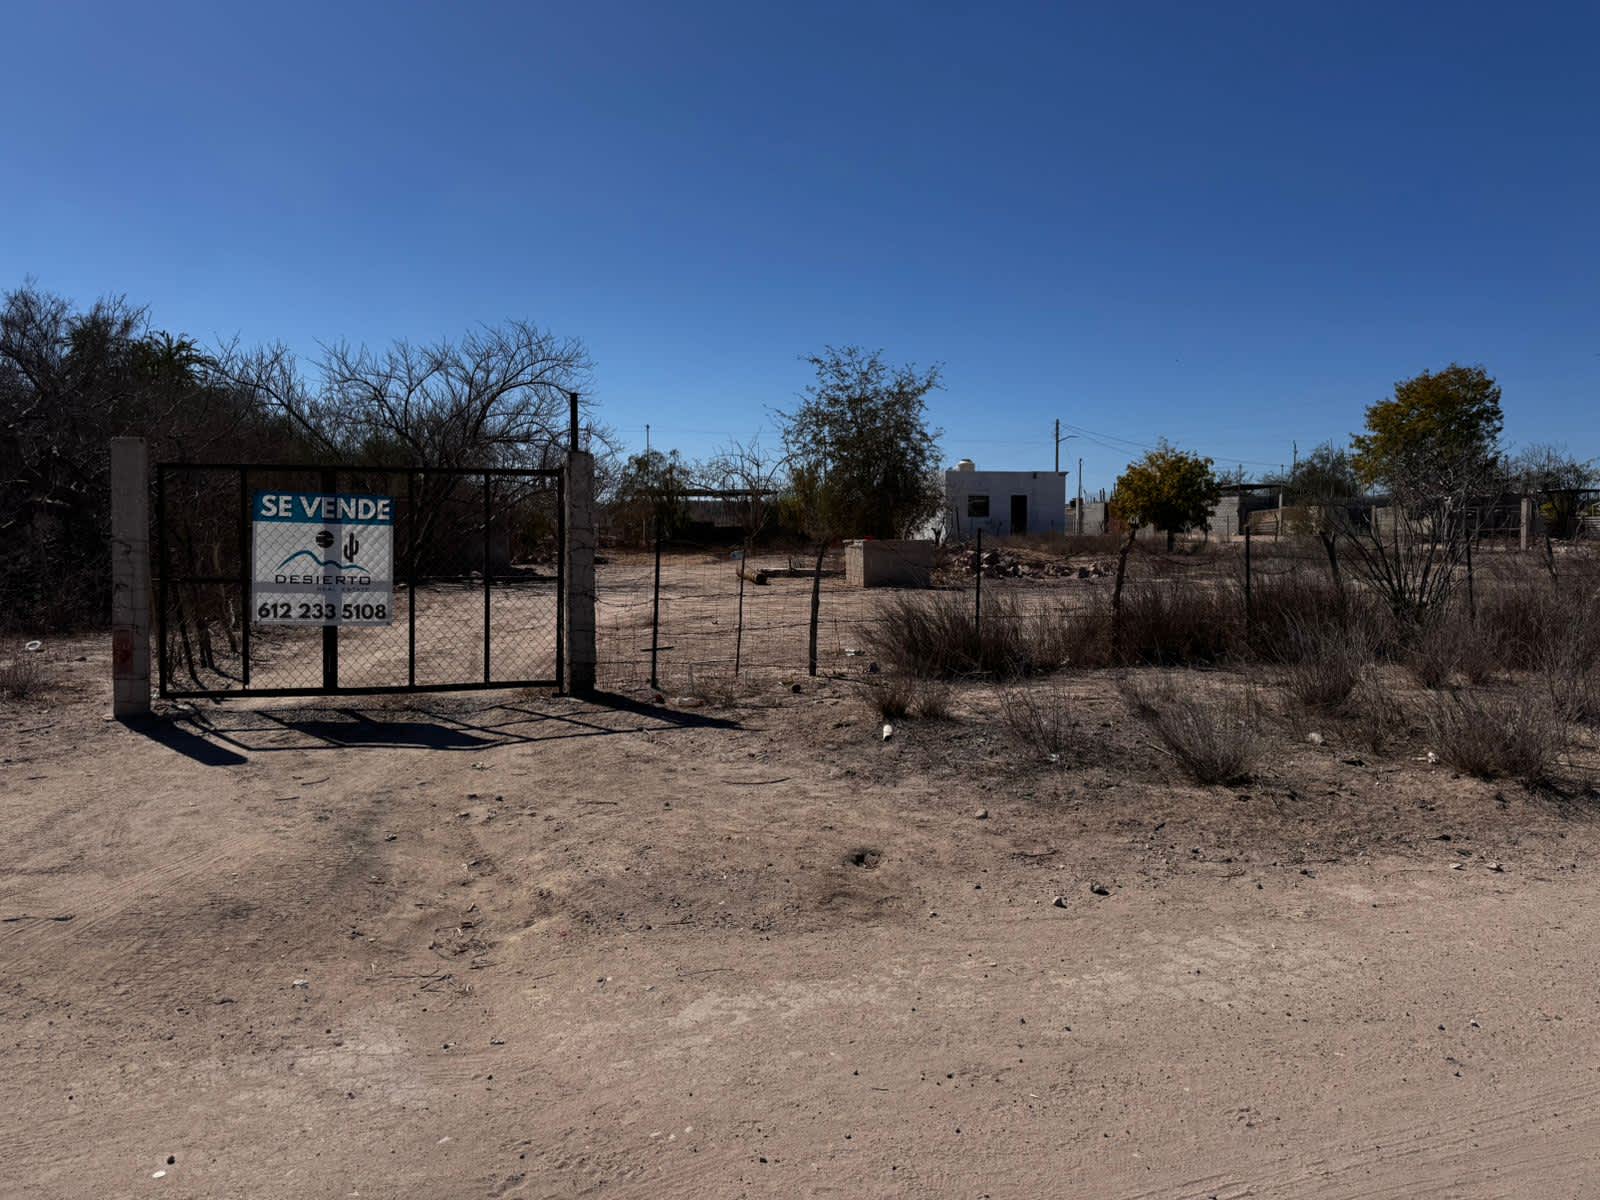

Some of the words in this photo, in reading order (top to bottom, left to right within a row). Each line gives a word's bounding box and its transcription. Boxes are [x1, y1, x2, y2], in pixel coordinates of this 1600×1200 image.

[260, 494, 292, 517] SE
[299, 496, 391, 520] VENDE
[275, 574, 371, 585] DESIERTO
[257, 603, 292, 619] 612
[298, 603, 336, 619] 233
[341, 604, 387, 620] 5108
